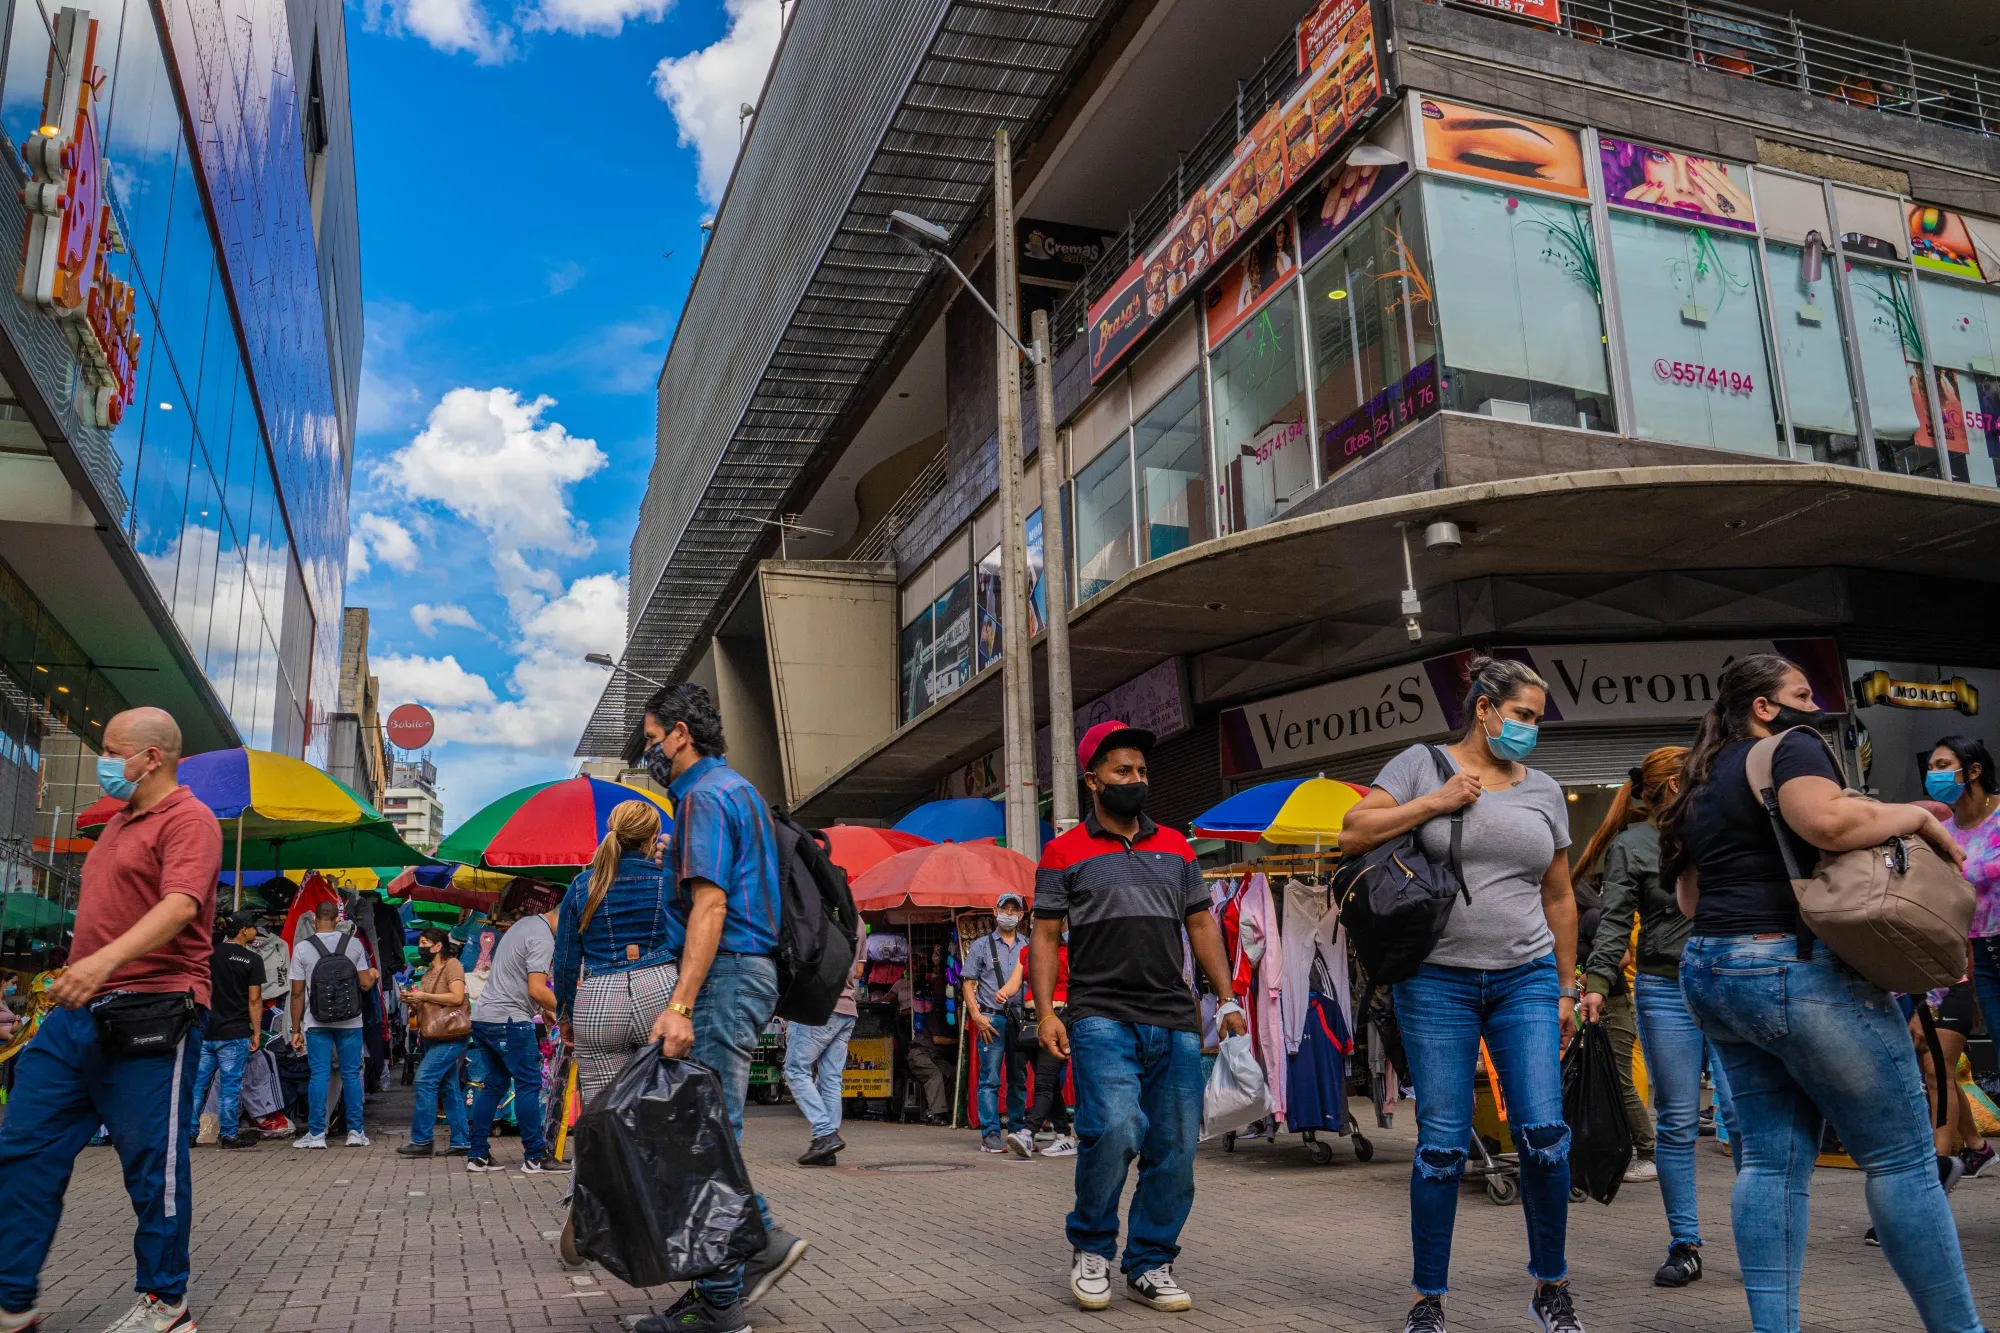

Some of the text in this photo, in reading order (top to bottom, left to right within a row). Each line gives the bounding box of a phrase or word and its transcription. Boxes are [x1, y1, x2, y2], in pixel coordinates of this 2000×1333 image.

[1305, 0, 1352, 48] DOMICILIO
[1513, 3, 1525, 13] 17
[1673, 361, 1754, 392] 5574194
[1375, 409, 1394, 437] 251
[1400, 395, 1414, 421] 51
[1417, 384, 1434, 408] 76
[1256, 418, 1303, 466] 5574194
[1551, 655, 1736, 706] Veron
[1896, 685, 1958, 703] MONACO
